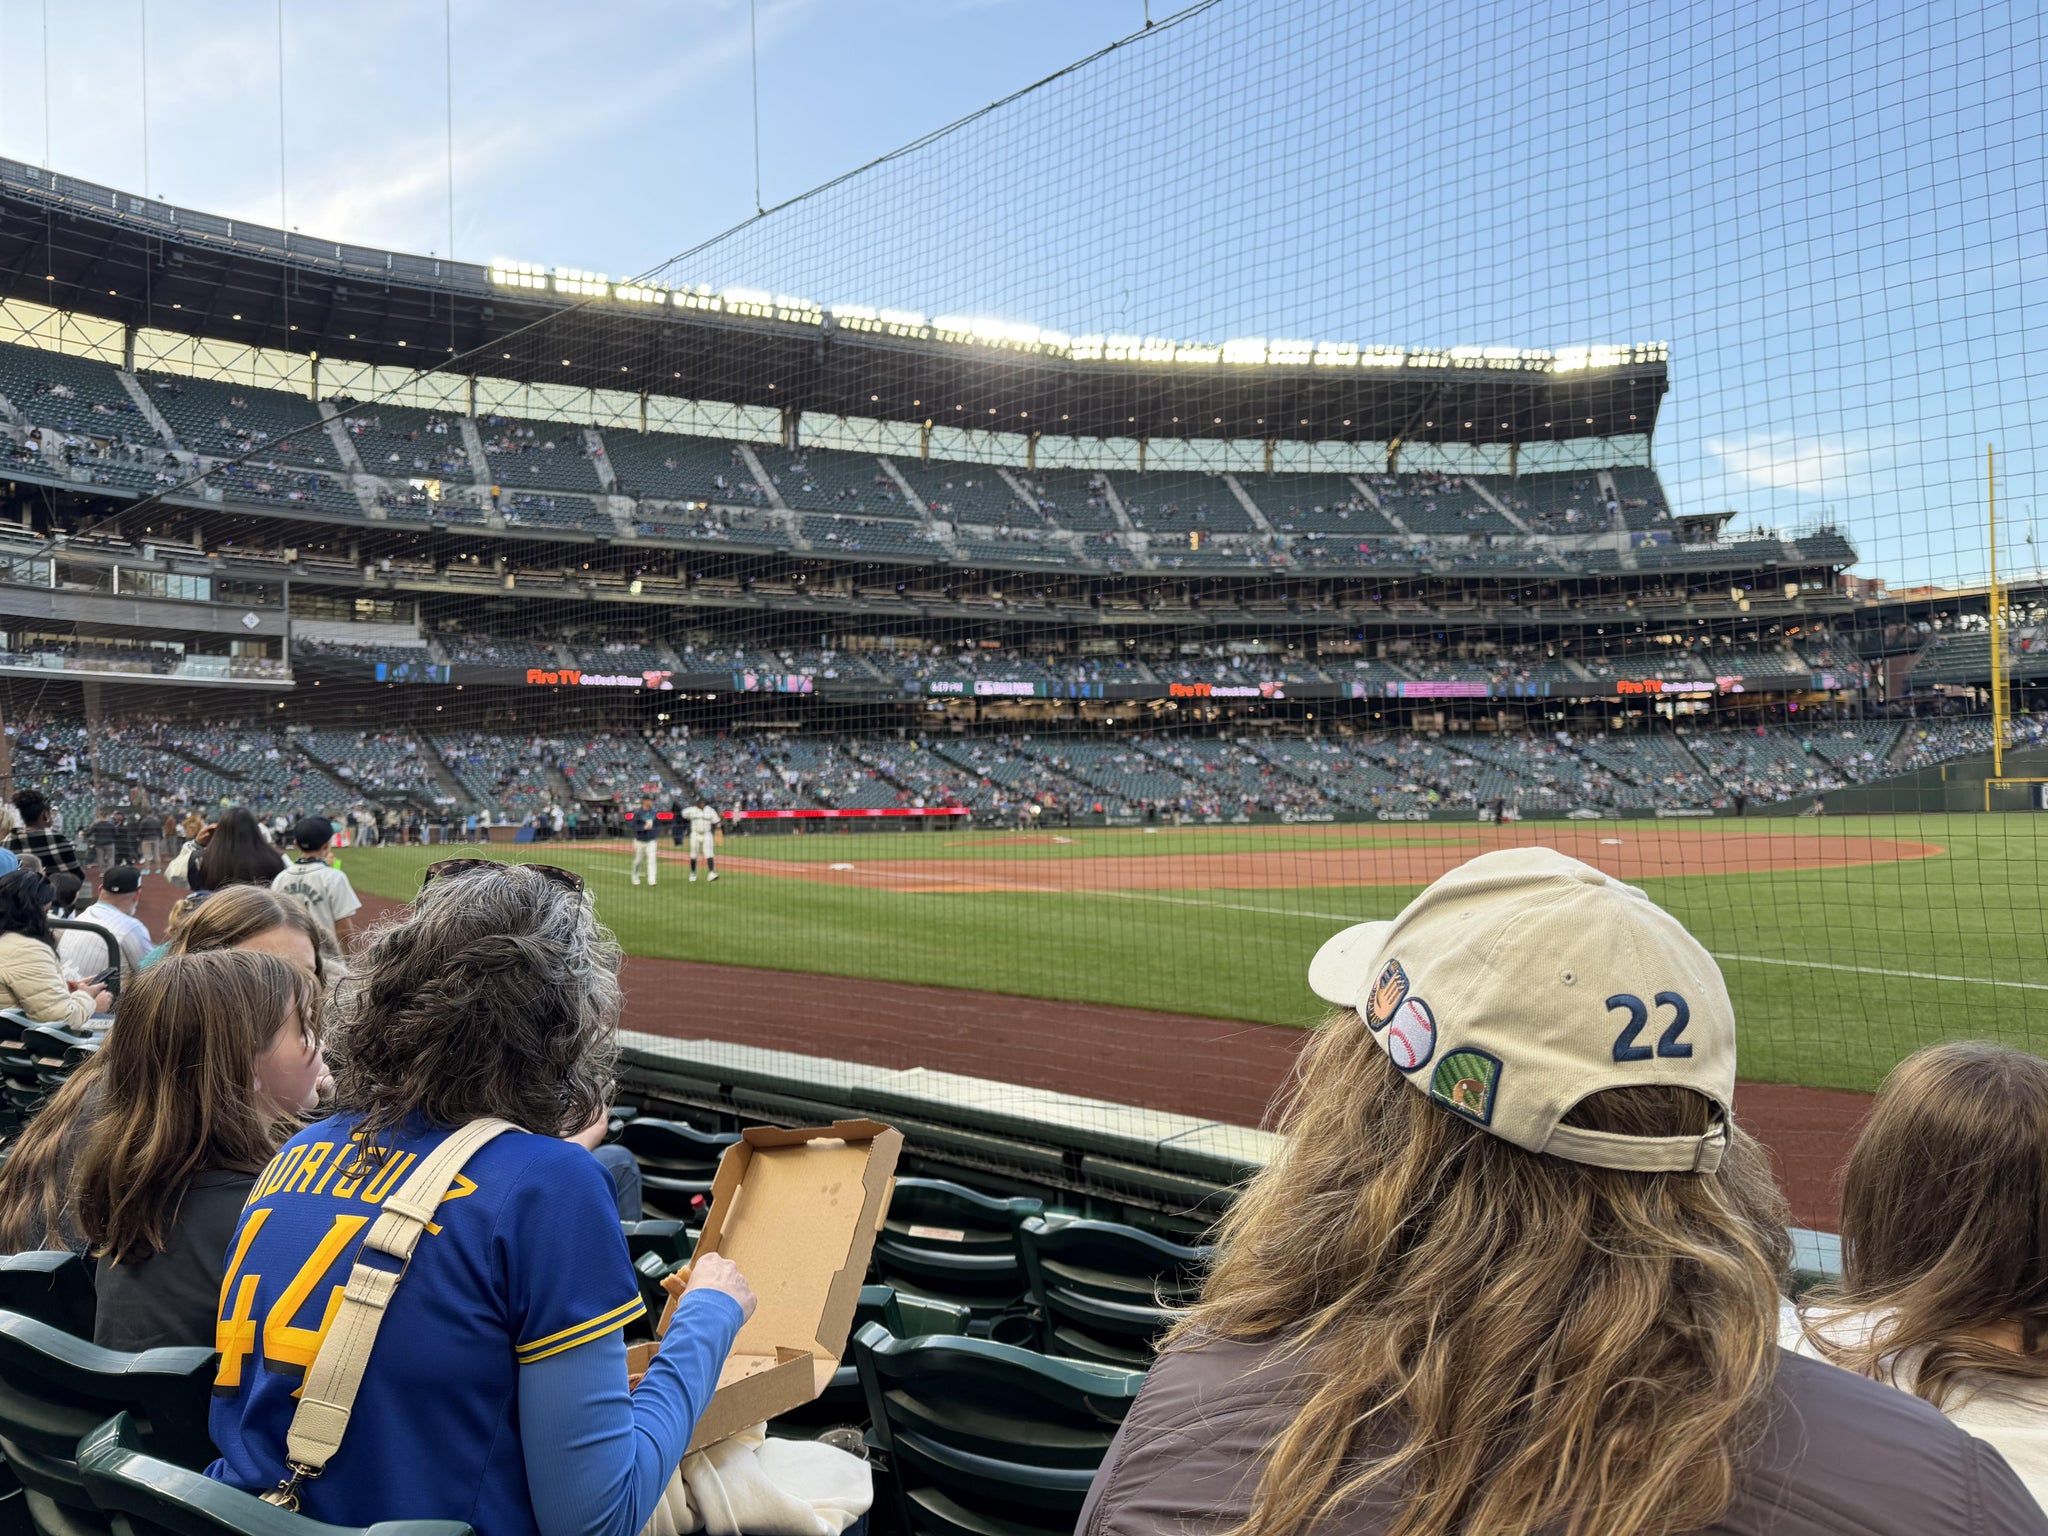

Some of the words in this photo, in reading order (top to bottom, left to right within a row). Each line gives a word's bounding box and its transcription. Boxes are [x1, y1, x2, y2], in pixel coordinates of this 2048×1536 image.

[527, 669, 558, 684] Fire
[558, 670, 580, 685] TV
[1170, 683, 1194, 697] Fire
[1194, 683, 1212, 697] TV
[1617, 680, 1644, 694] Fire
[1643, 680, 1663, 693] TV
[1606, 991, 1692, 1062] 22
[213, 1208, 370, 1398] 44
